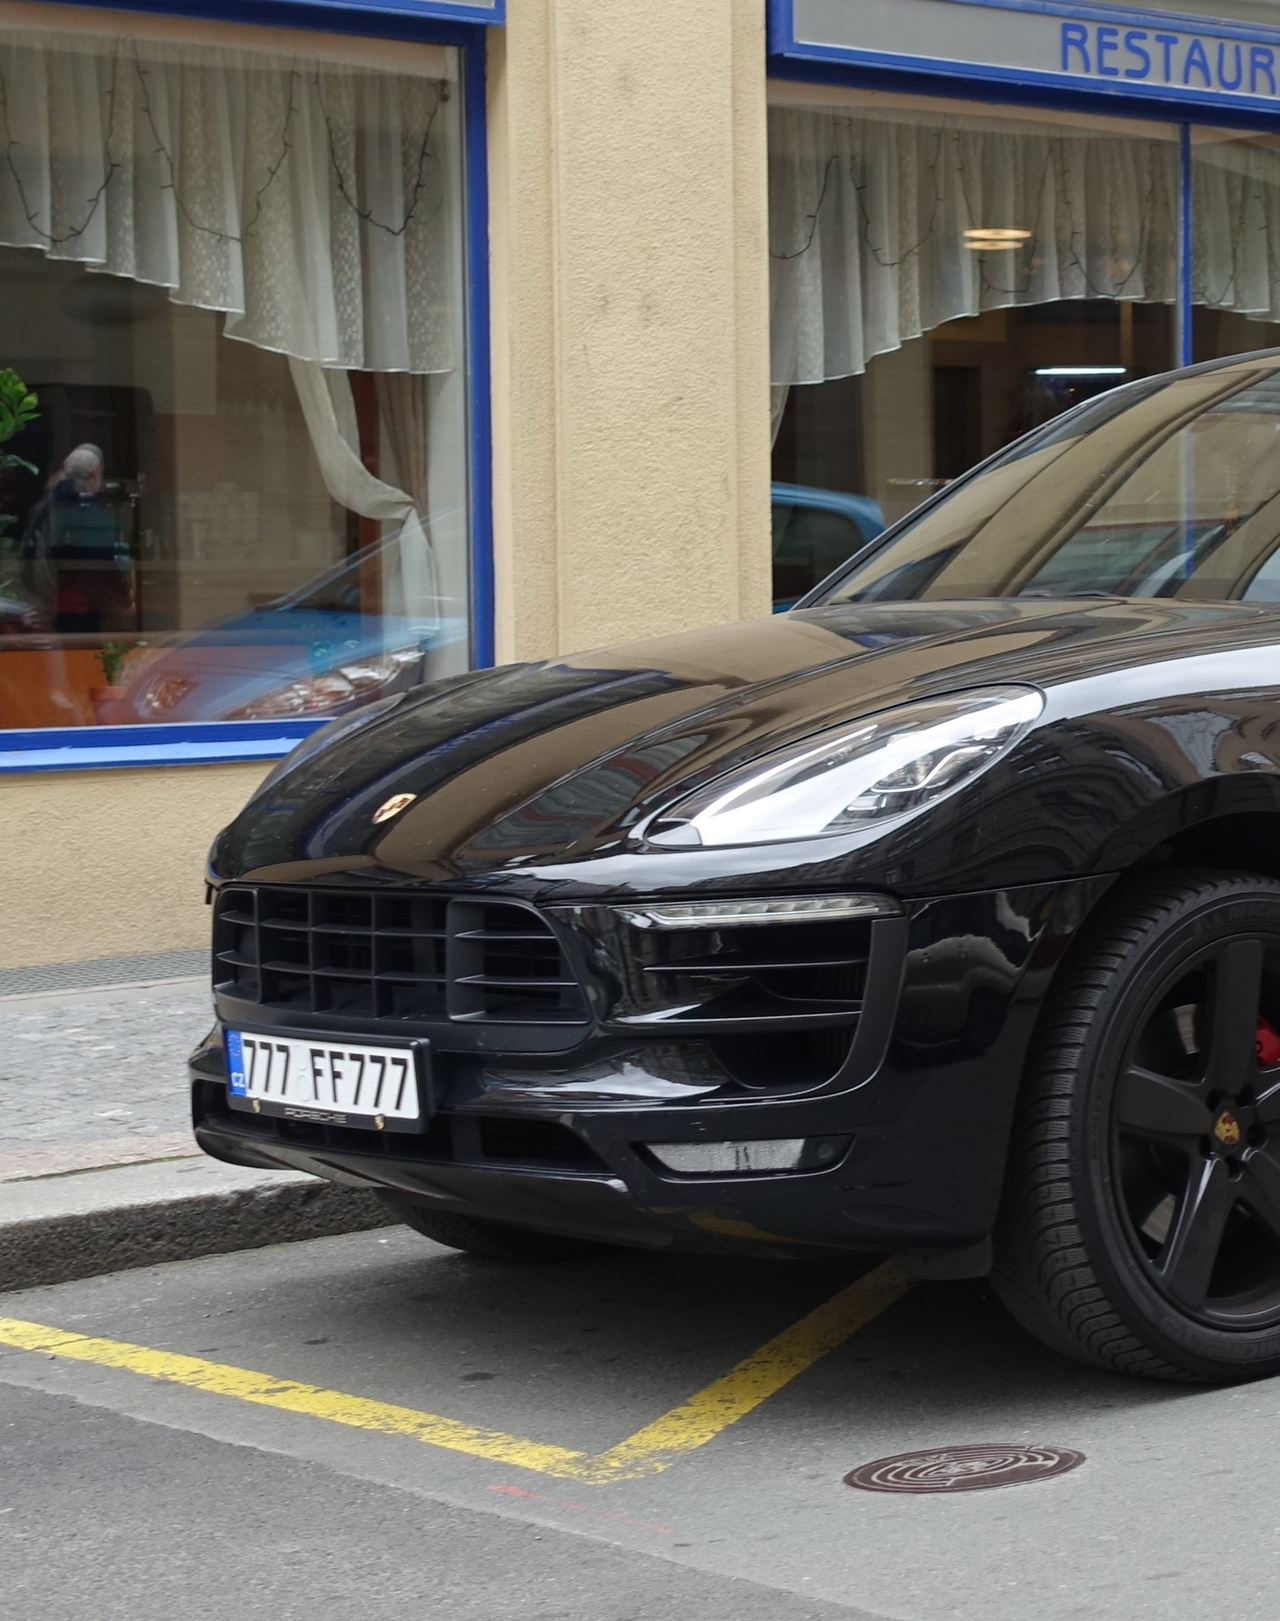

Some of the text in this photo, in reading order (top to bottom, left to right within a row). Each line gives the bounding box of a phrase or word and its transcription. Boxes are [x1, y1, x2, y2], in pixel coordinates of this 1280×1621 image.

[231, 1071, 245, 1088] CZ
[243, 1038, 408, 1110] 777 FF777
[284, 1106, 347, 1124] PORSCHE
